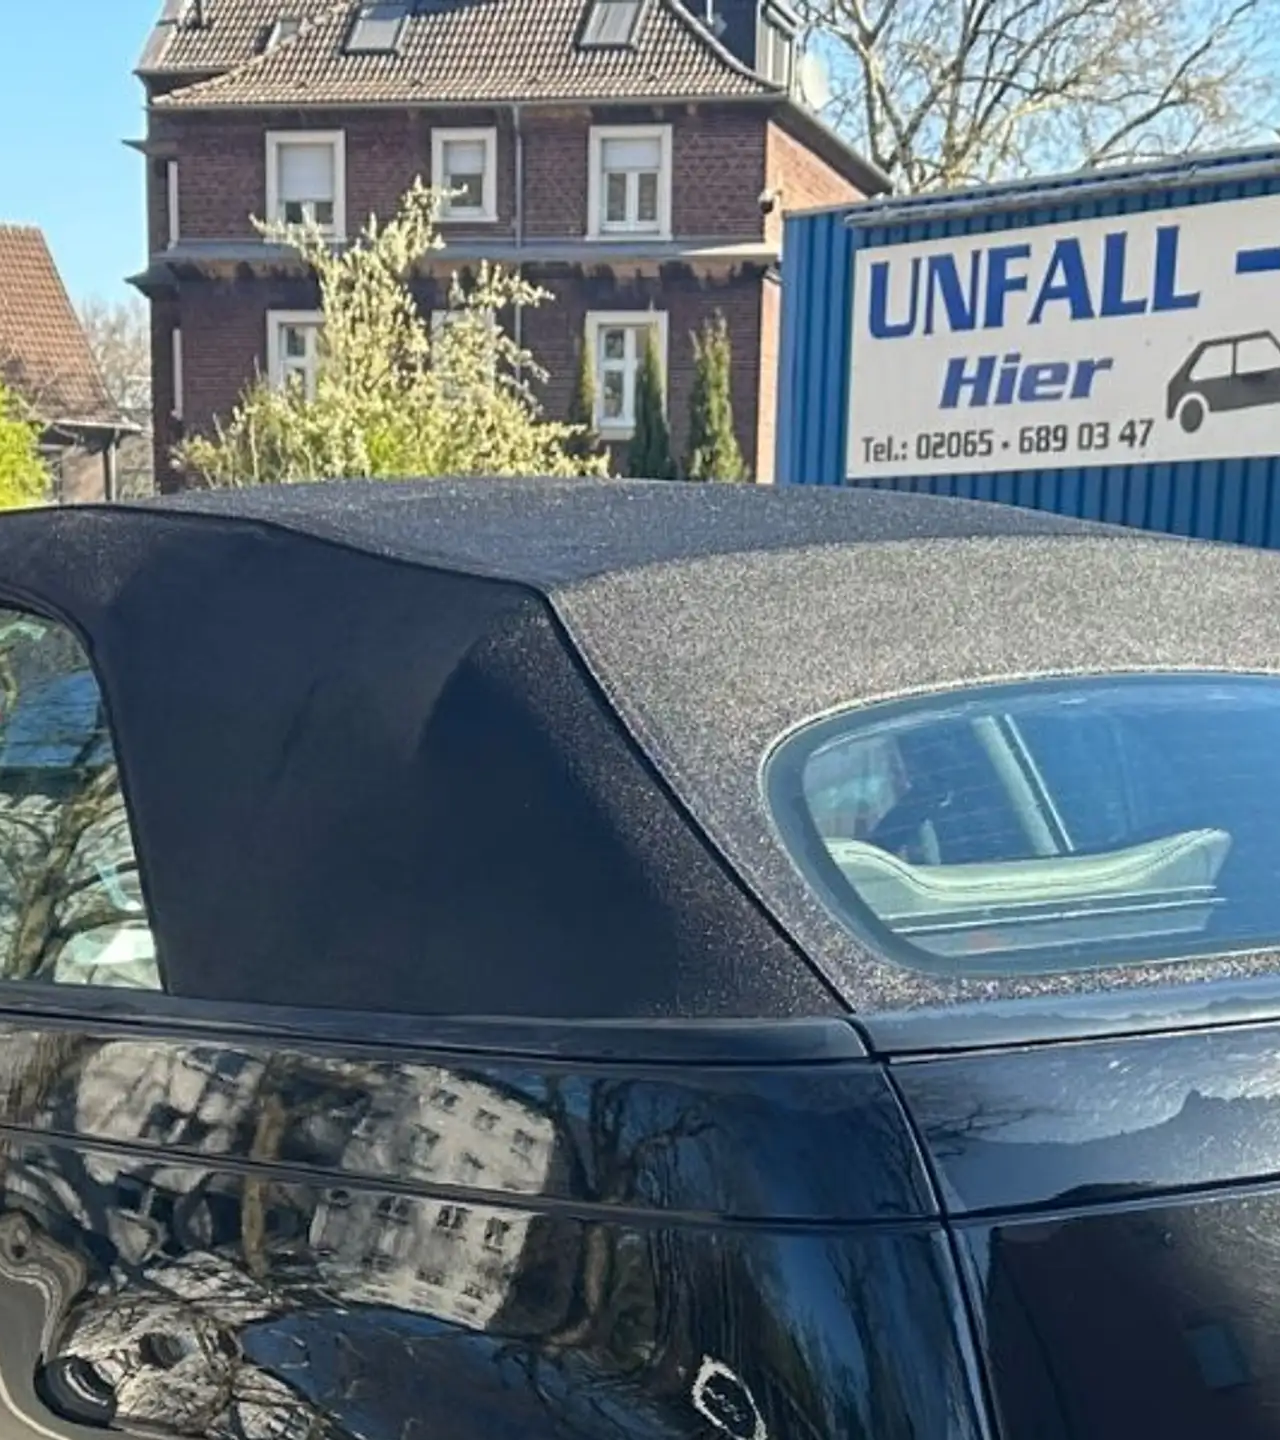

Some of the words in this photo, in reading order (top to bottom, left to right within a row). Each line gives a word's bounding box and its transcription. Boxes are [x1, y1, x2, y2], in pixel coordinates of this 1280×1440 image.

[868, 225, 1201, 341] UNFALL
[938, 357, 1114, 410] Hier
[862, 436, 908, 463] Tel.:
[916, 428, 994, 460] 02065
[1019, 424, 1069, 454] 689
[1078, 421, 1110, 451] 03
[1119, 418, 1155, 449] 47
